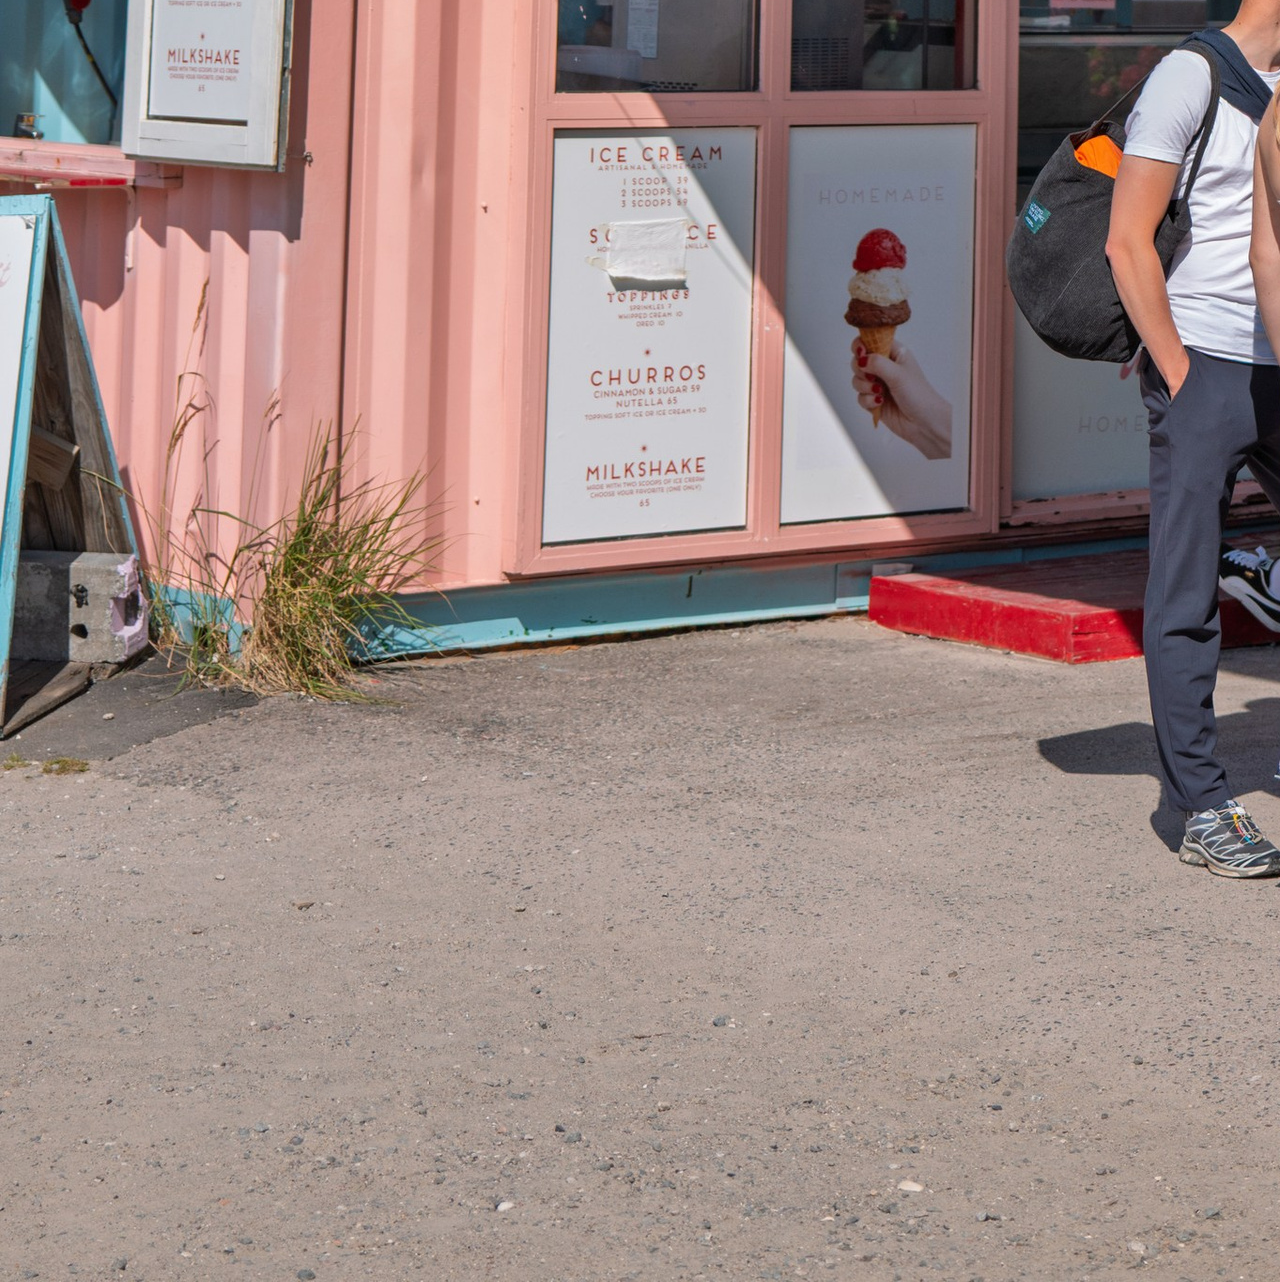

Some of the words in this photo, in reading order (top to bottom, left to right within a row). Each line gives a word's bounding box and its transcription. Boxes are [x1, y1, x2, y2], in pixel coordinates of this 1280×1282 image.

[167, 48, 240, 65] MILKSHAKE
[589, 146, 627, 163] ICE
[642, 145, 722, 162] CREAM
[598, 164, 647, 172] ARTISANAL
[660, 162, 708, 170] HOMEMADE
[632, 176, 668, 186] SCOOP
[677, 176, 689, 185] 39
[620, 188, 627, 197] 2
[631, 187, 672, 197] SCOOPS
[676, 187, 688, 196] 54
[818, 186, 945, 205] HOMEMADE
[620, 199, 627, 208] 3
[631, 198, 672, 208] SCOOPS
[687, 224, 717, 240] CE
[607, 289, 690, 303] TOPPINGS
[590, 364, 706, 386] CHURROS
[593, 388, 646, 399] CINNAMON
[648, 386, 654, 395] &
[657, 385, 688, 395] SUGAR
[690, 384, 701, 393] 59
[616, 397, 663, 408] NUTELLA
[666, 396, 678, 405] 65
[1078, 415, 1145, 433] HOME
[586, 456, 706, 482] MILKSHAKE
[639, 498, 651, 507] 65
